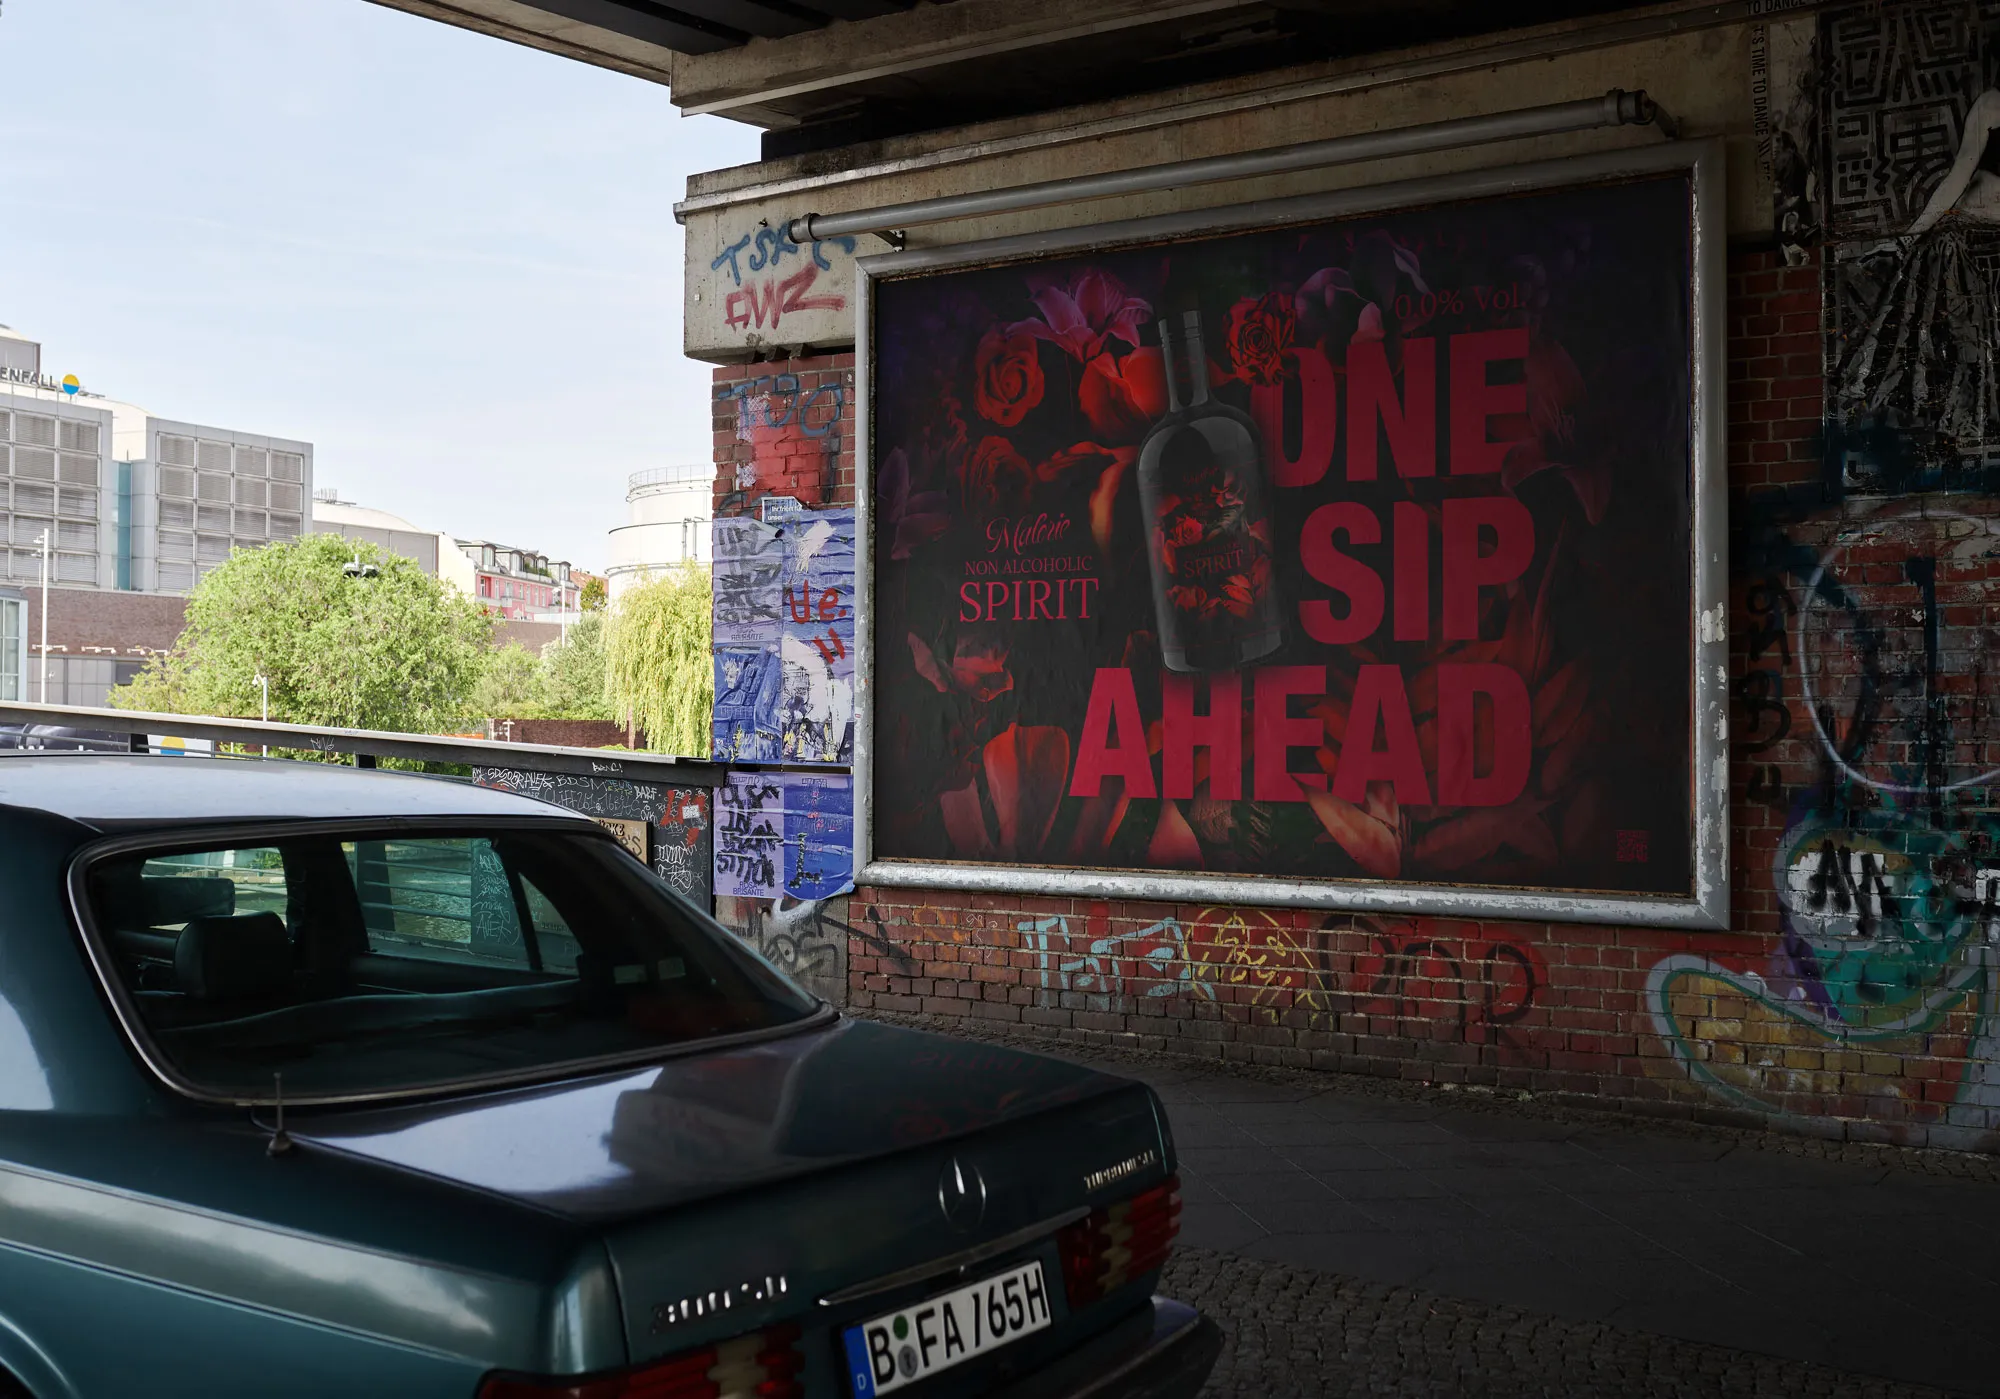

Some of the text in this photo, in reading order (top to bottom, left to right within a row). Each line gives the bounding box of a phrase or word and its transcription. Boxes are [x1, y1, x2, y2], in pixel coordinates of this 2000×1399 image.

[1765, 0, 1806, 12] DANC
[1751, 46, 1766, 77] TIME
[1753, 78, 1767, 94] TO
[1753, 97, 1769, 136] DANCE
[1395, 286, 1465, 320] 0.0%
[1250, 327, 1530, 488] ONE
[965, 555, 1093, 576] NON ALCOHOLIC
[1184, 550, 1244, 580] SPIRIT
[1297, 495, 1535, 645] SIP
[959, 577, 1100, 623] SPIRIT
[1069, 664, 1532, 807] AHEAD
[868, 1326, 895, 1386] B
[916, 1301, 965, 1369] FA
[857, 1372, 867, 1391] D
